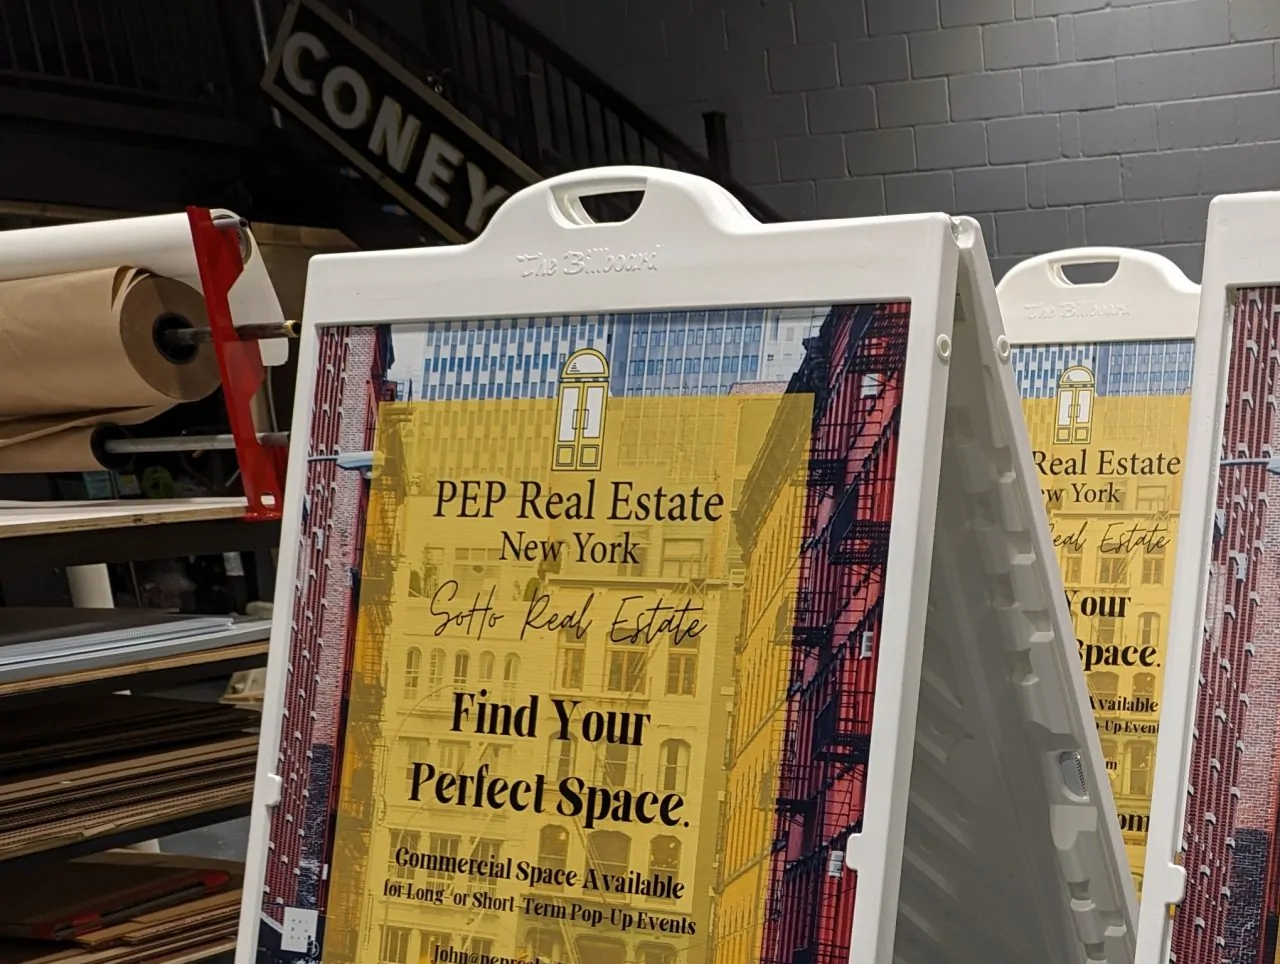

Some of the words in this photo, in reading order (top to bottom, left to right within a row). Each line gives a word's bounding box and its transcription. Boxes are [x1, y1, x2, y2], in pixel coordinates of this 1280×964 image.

[282, 30, 510, 230] CONEY
[516, 252, 557, 278] The
[1032, 448, 1087, 476] Real
[1096, 450, 1181, 476] Estate
[433, 480, 507, 518] PEP
[516, 478, 596, 521] Real
[606, 481, 725, 522] Estate
[1072, 482, 1121, 504] York
[499, 530, 566, 563] New
[572, 531, 641, 564] York
[1100, 521, 1172, 554] Estate
[429, 579, 504, 641] SoHo
[520, 587, 595, 640] Real
[609, 595, 708, 646] Estate
[449, 688, 539, 738] Find
[551, 698, 651, 746] Your
[408, 761, 548, 814] Perfect
[556, 776, 690, 829] Space.
[395, 846, 512, 880] Commercial
[515, 860, 578, 889] Space
[581, 868, 685, 900] Available
[383, 879, 404, 897] for
[453, 892, 470, 906] or
[472, 892, 566, 919] Short-Term
[570, 903, 632, 931] Pop-Up
[636, 912, 697, 935] Events
